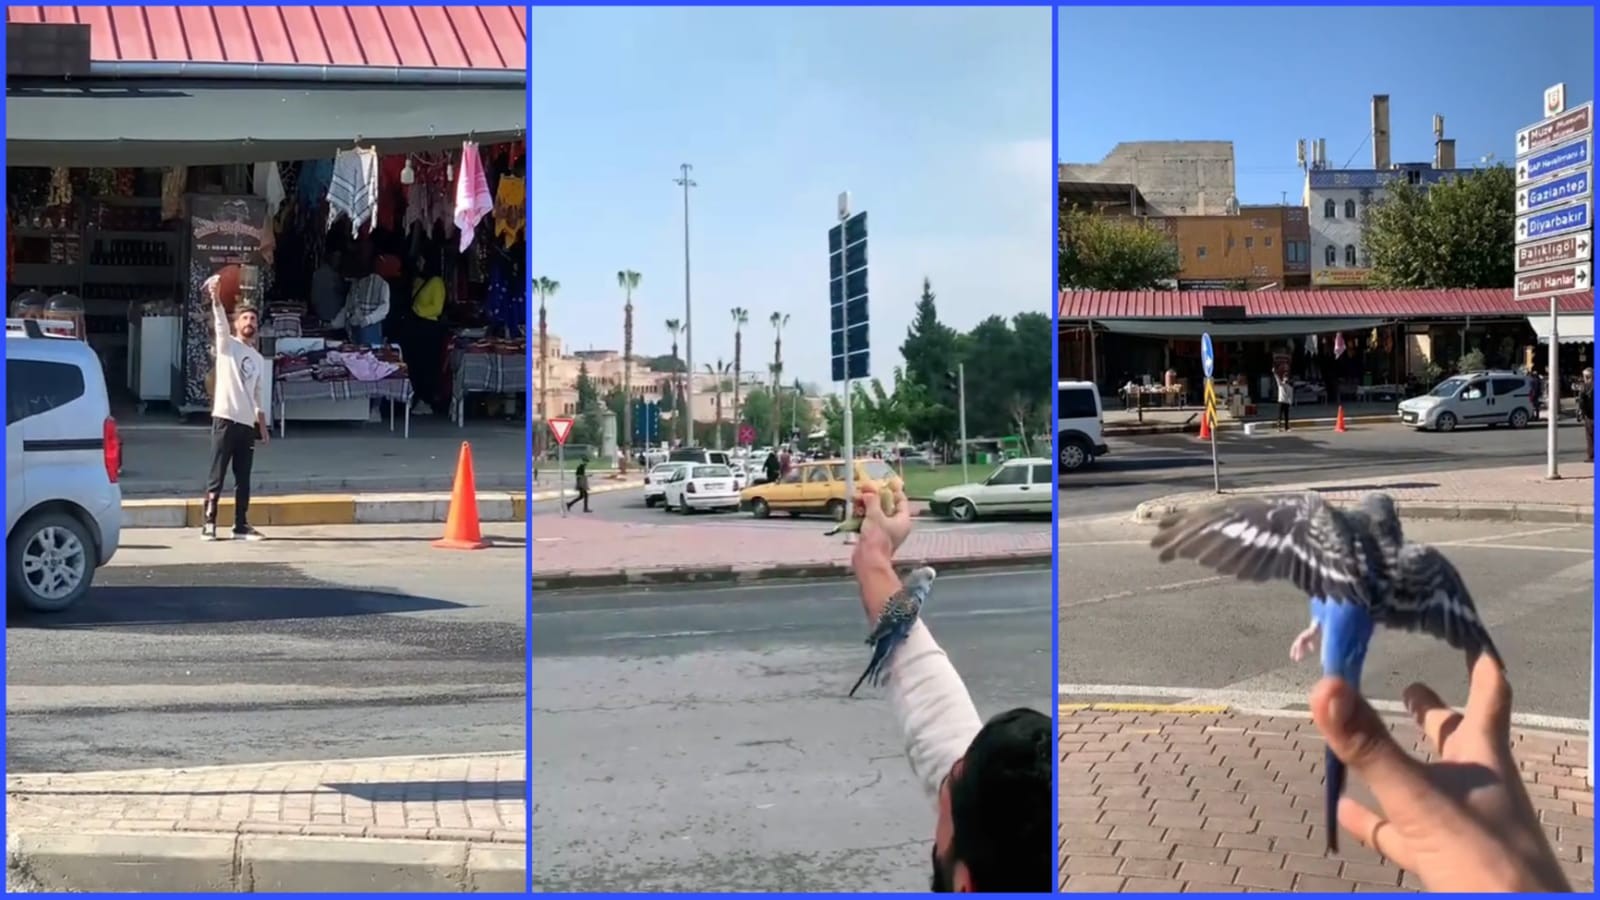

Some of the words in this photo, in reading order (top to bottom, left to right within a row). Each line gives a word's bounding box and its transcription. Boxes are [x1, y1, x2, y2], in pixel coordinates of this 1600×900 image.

[1530, 180, 1585, 203] Gaziantep
[1530, 211, 1584, 233] Diyarbakır
[1519, 279, 1542, 292] Tarihi
[1544, 273, 1574, 289] Hanlar
